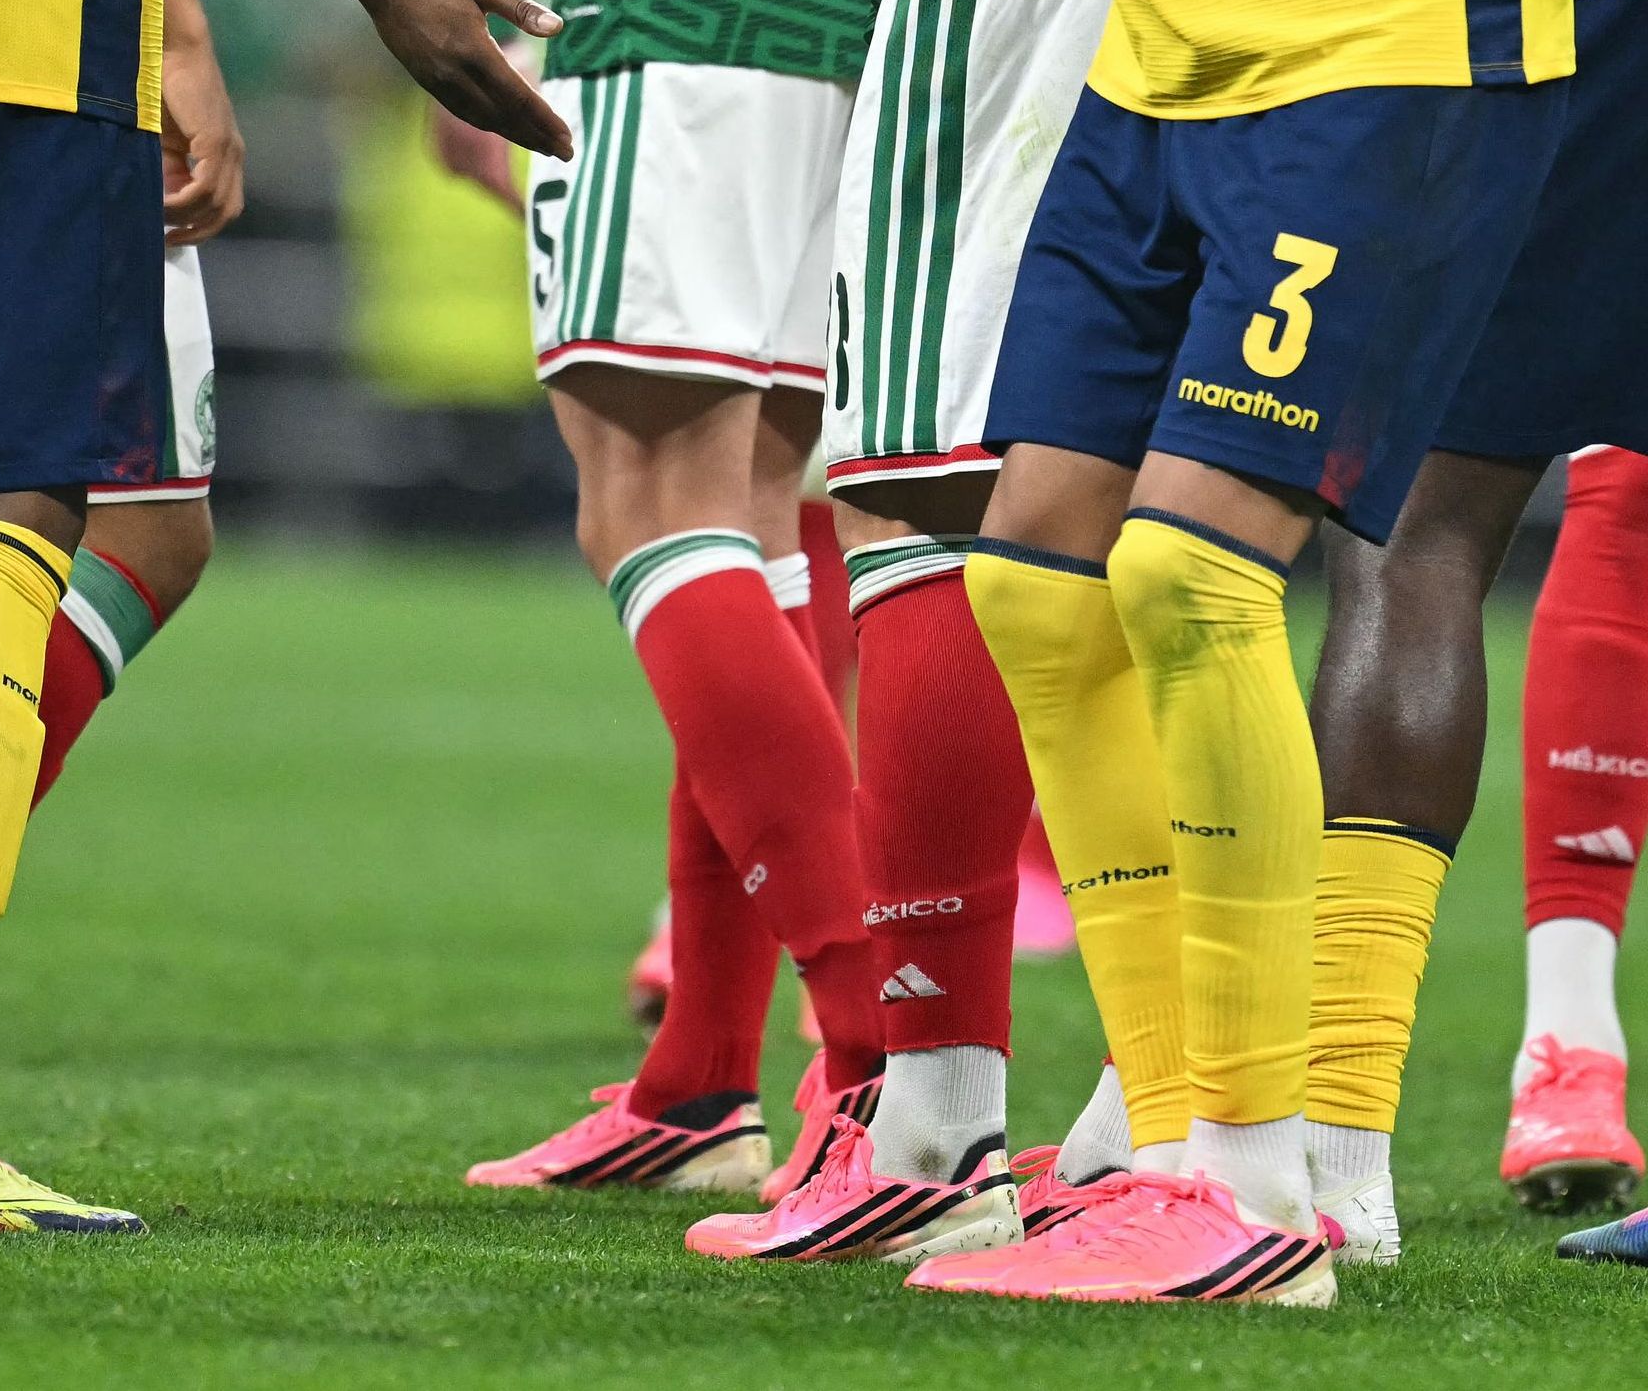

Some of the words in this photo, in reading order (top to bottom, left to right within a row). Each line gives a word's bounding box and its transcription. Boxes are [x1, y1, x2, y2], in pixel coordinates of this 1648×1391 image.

[1242, 231, 1339, 378] 3
[1177, 377, 1321, 433] marathon
[862, 895, 964, 928] MÉXICO
